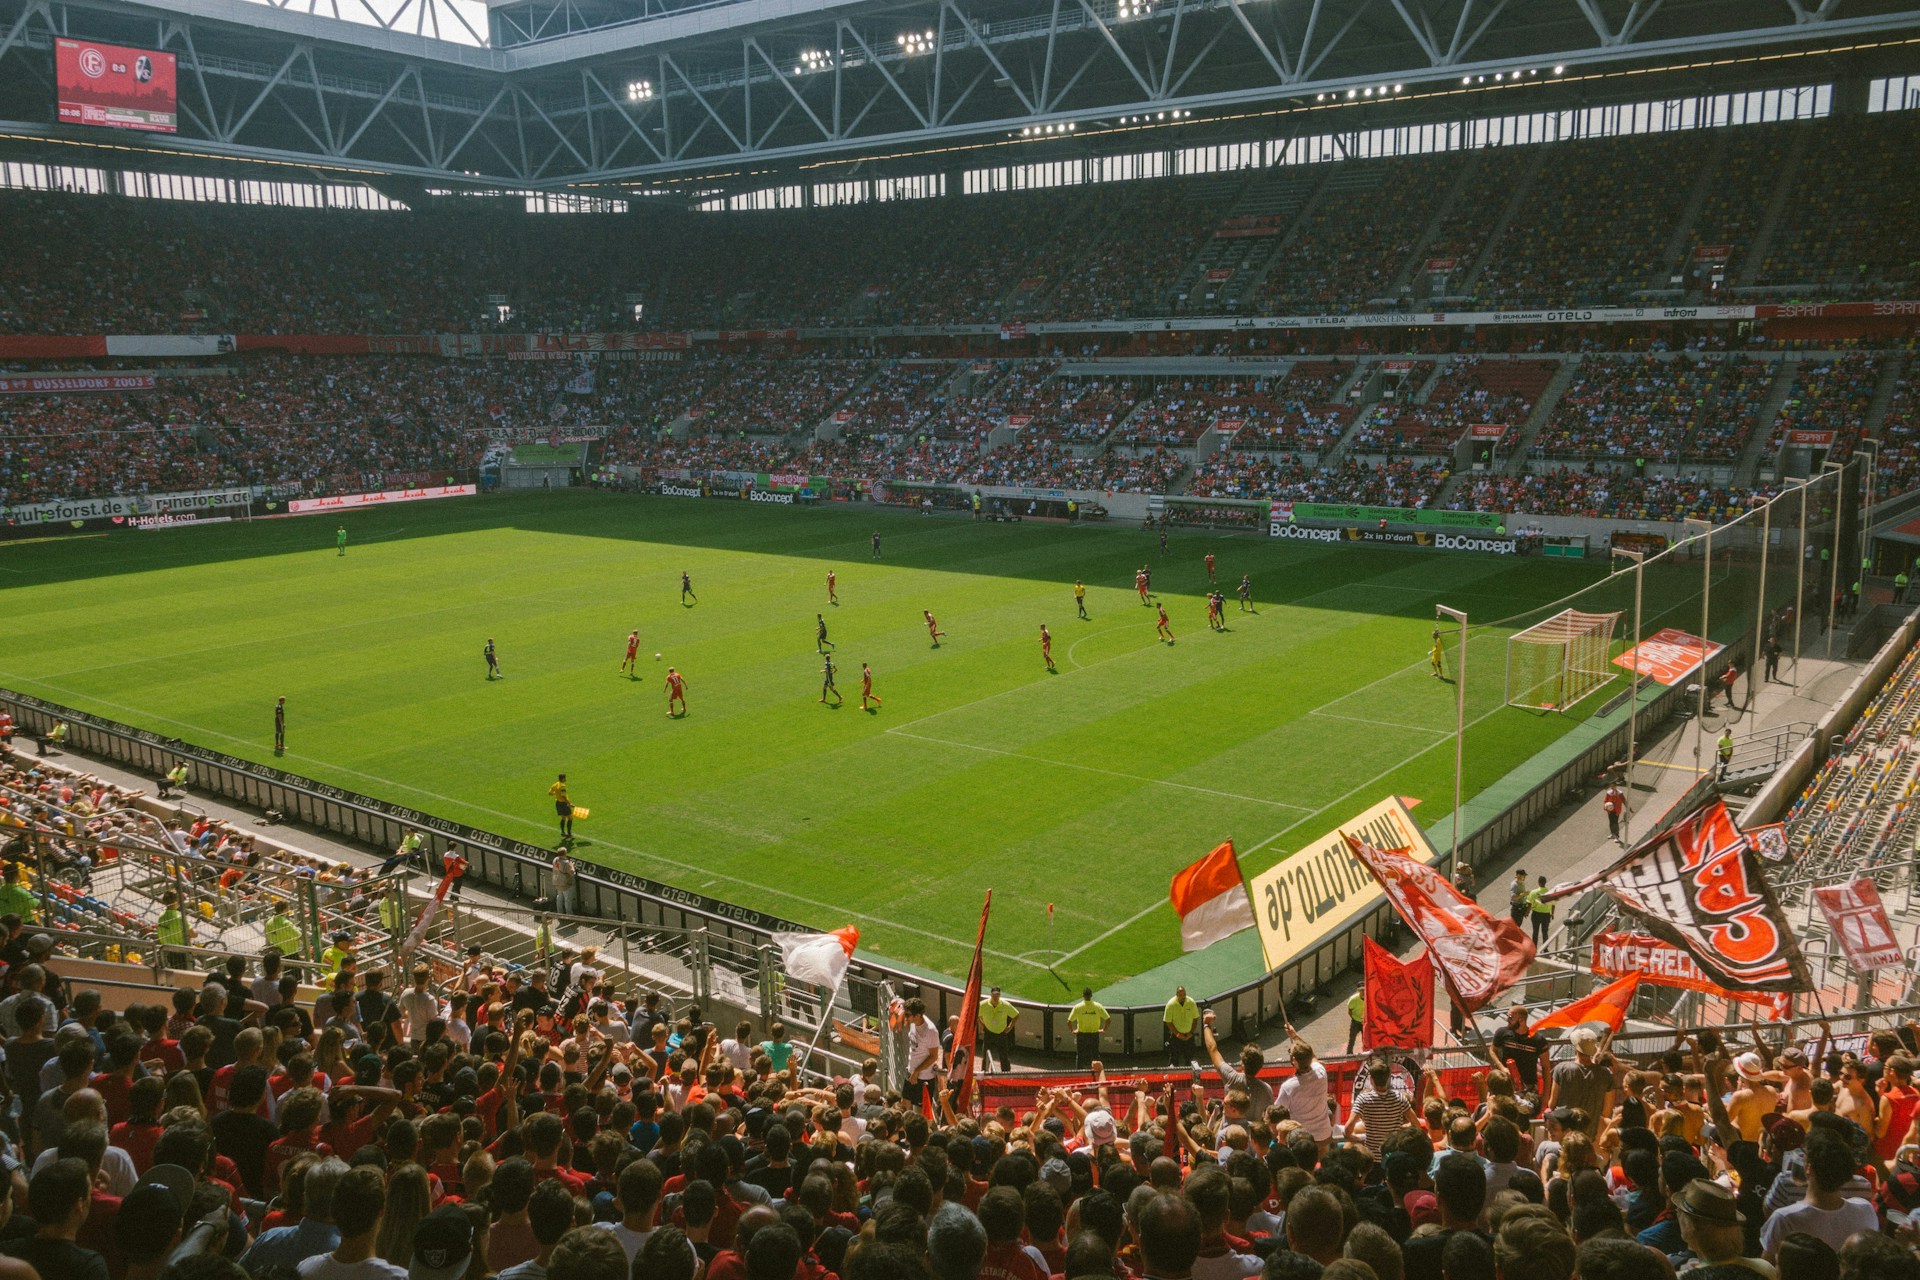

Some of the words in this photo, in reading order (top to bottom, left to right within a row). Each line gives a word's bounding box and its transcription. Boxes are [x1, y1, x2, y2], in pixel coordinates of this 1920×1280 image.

[1664, 309, 1697, 317] infront
[1777, 305, 1826, 317] ESPRIT
[1364, 314, 1416, 323] WARSTEINER
[507, 352, 545, 360] DIVISION
[33, 379, 109, 389] DÜSSELDORF
[113, 378, 143, 386] 2003
[1796, 433, 1826, 441] ESPRIT
[662, 485, 701, 498] BoConcept
[750, 491, 793, 504] BoConcept
[128, 514, 196, 526] H-Hotels.com
[1270, 523, 1342, 542] BoConcept
[1385, 534, 1413, 542] D'dorf!
[1435, 533, 1517, 554] BoConcept
